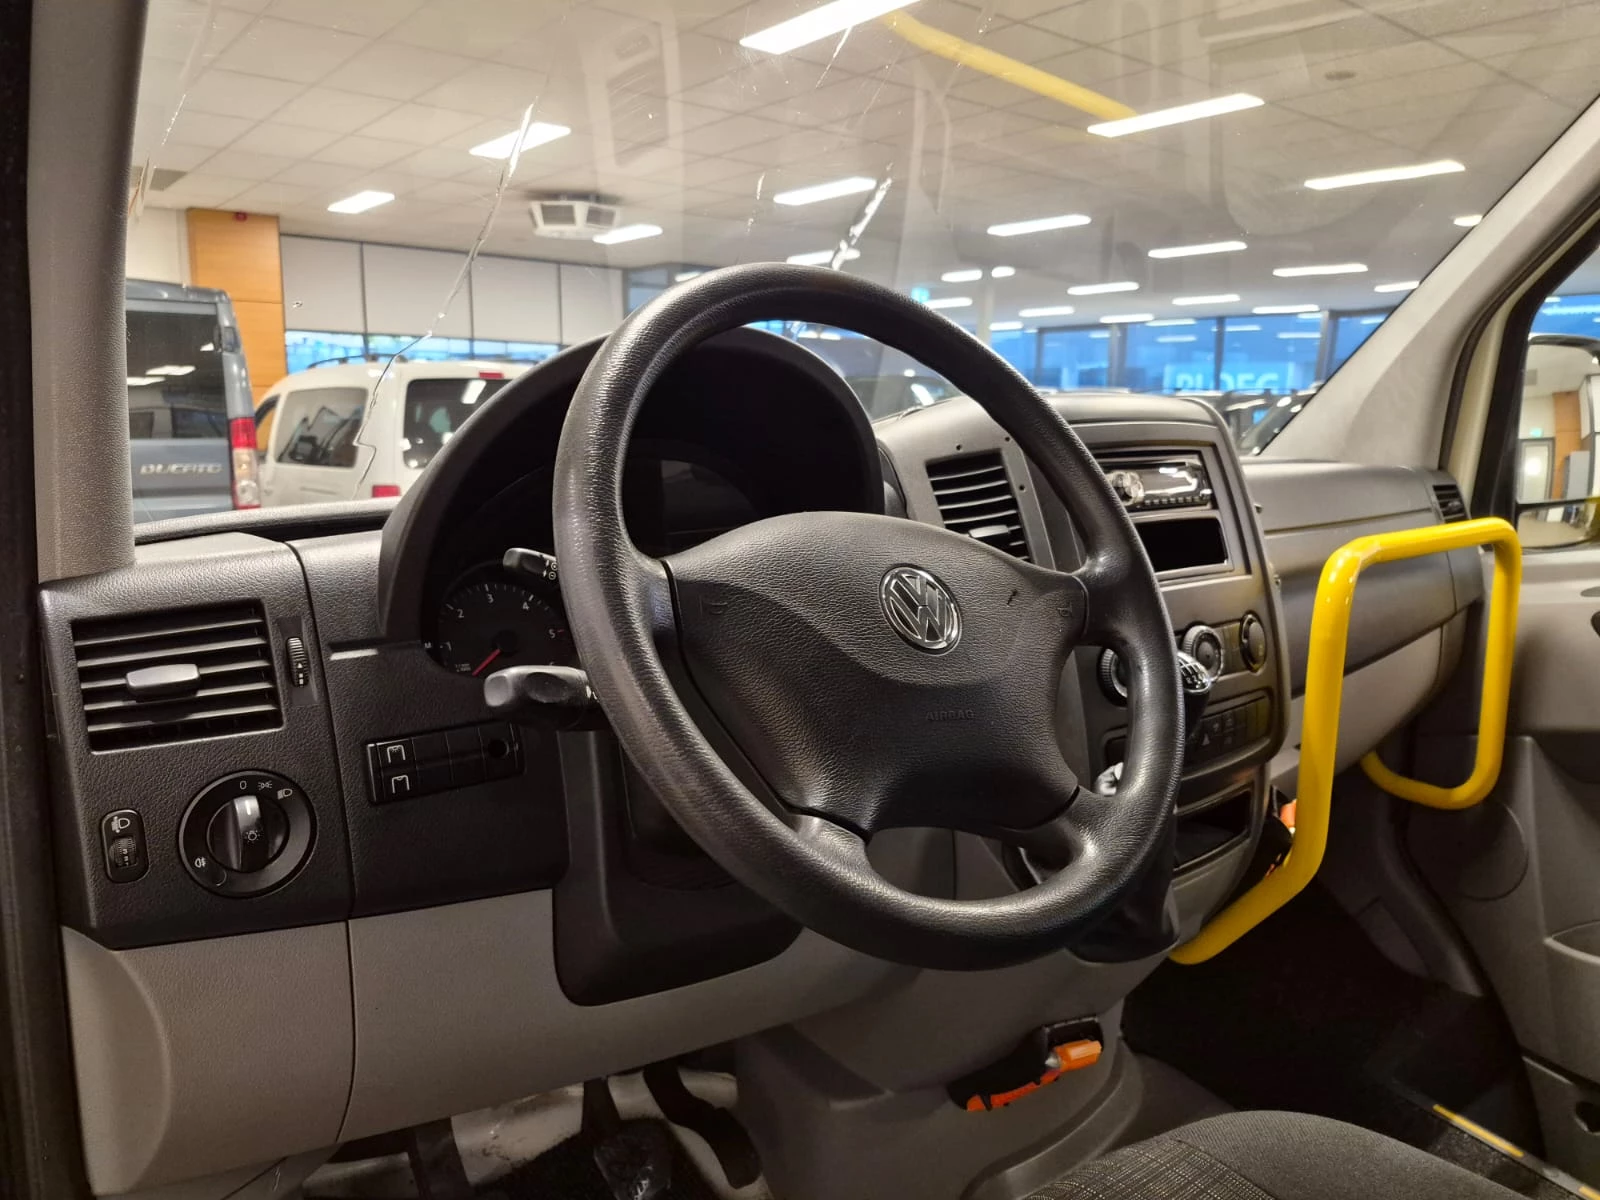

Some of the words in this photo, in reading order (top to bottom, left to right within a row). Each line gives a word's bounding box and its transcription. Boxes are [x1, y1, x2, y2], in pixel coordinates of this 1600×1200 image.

[487, 594, 494, 603] 3
[522, 602, 530, 610] 4
[457, 609, 464, 618] 2
[548, 629, 556, 638] 5
[925, 709, 975, 721] AIRBAG
